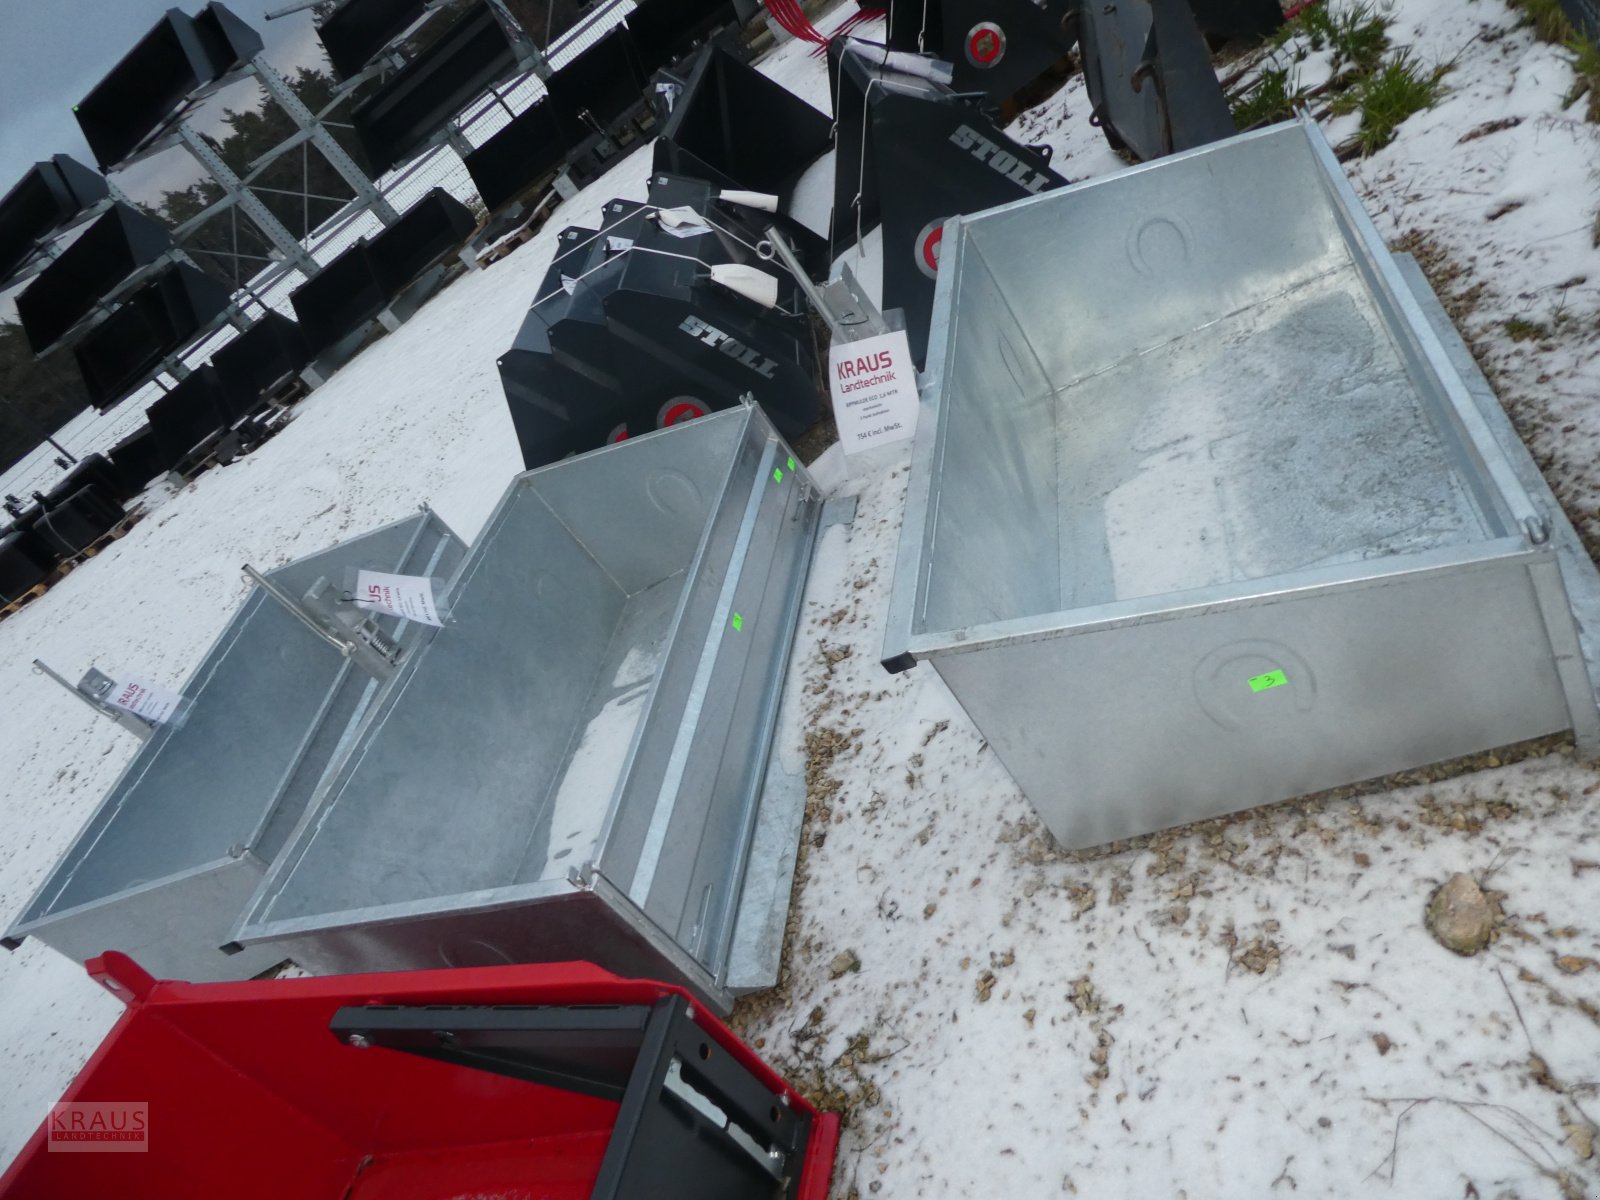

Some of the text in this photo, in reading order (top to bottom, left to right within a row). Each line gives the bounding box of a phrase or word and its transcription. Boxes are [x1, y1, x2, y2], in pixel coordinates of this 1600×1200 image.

[949, 124, 1050, 194] STOLL
[678, 315, 778, 379] STOLL
[836, 350, 893, 380] KRAUS
[840, 371, 896, 394] Landtechnik
